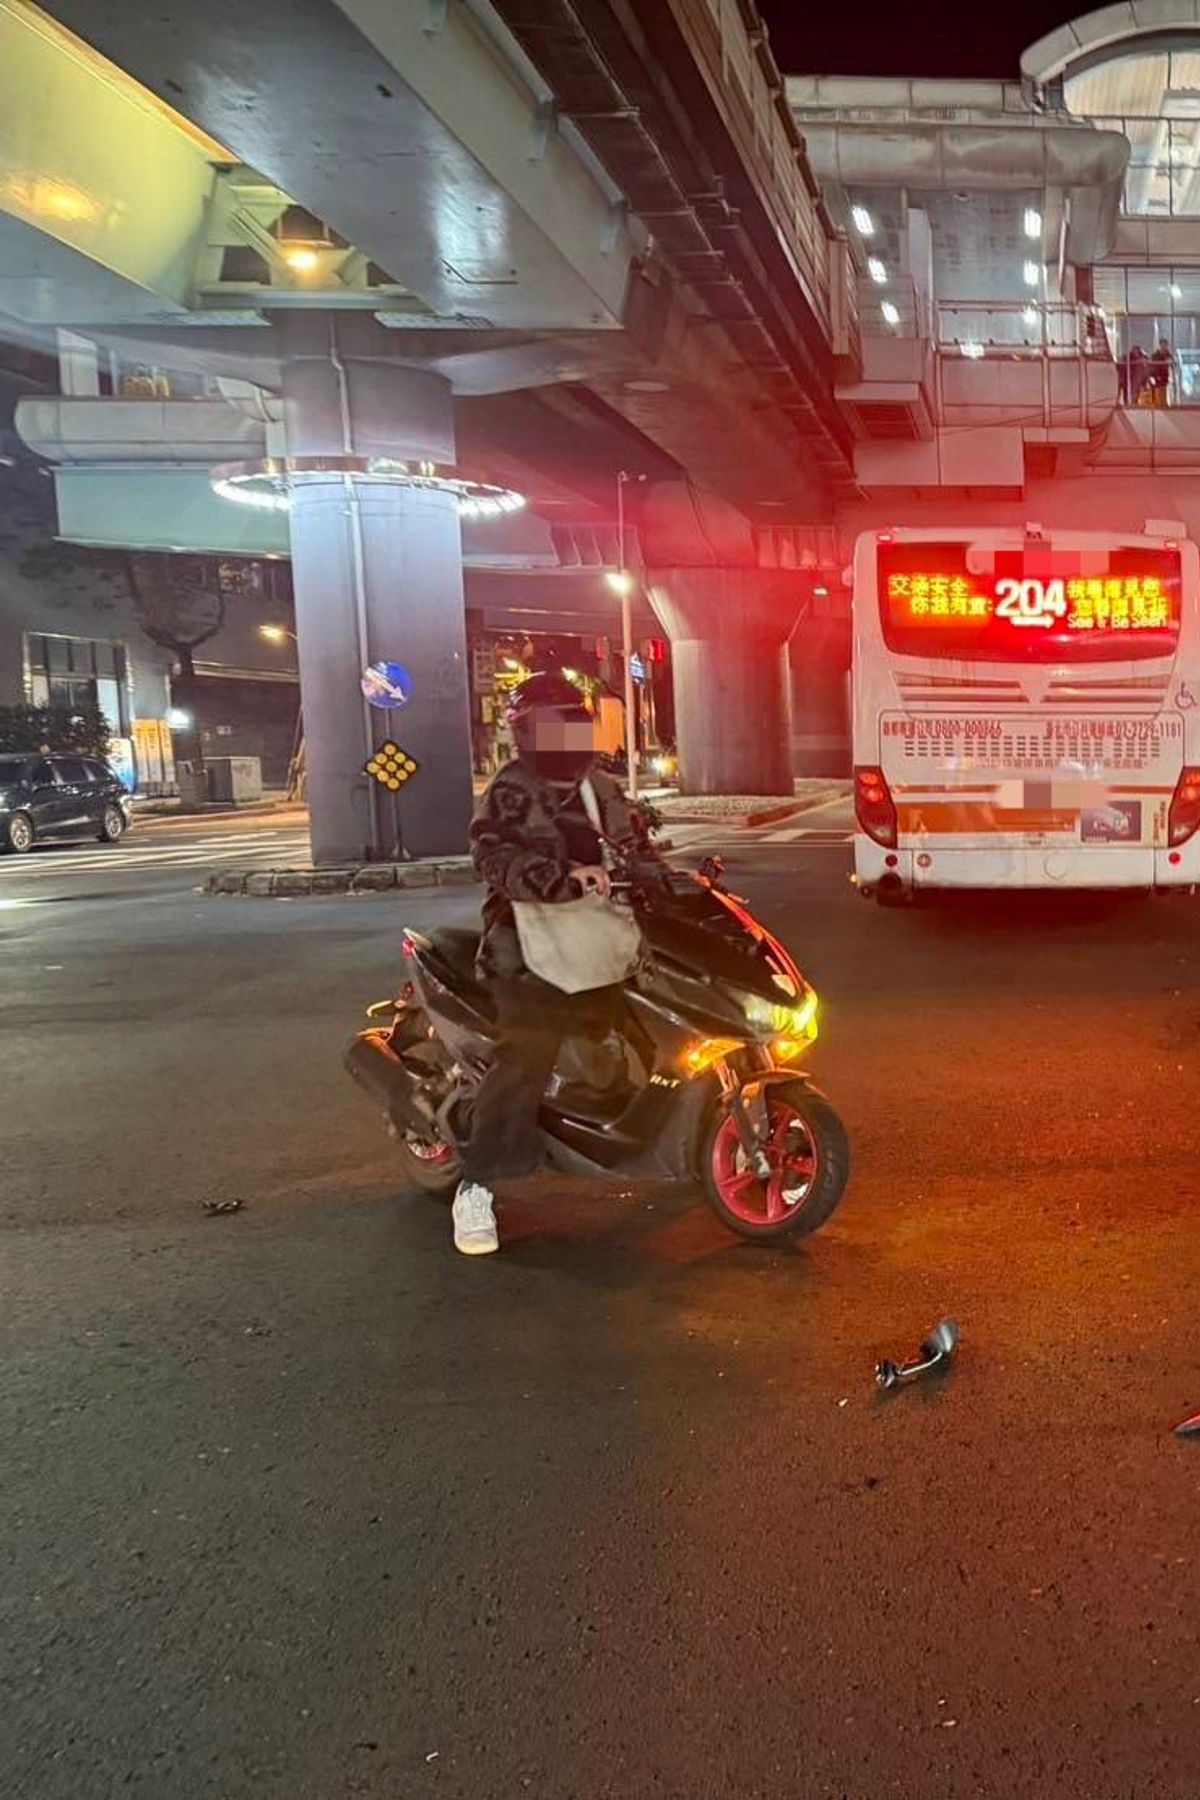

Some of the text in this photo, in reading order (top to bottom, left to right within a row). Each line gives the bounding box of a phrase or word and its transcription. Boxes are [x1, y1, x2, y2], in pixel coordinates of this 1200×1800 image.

[888, 573, 968, 597] 交通安全
[994, 577, 1067, 617] 204
